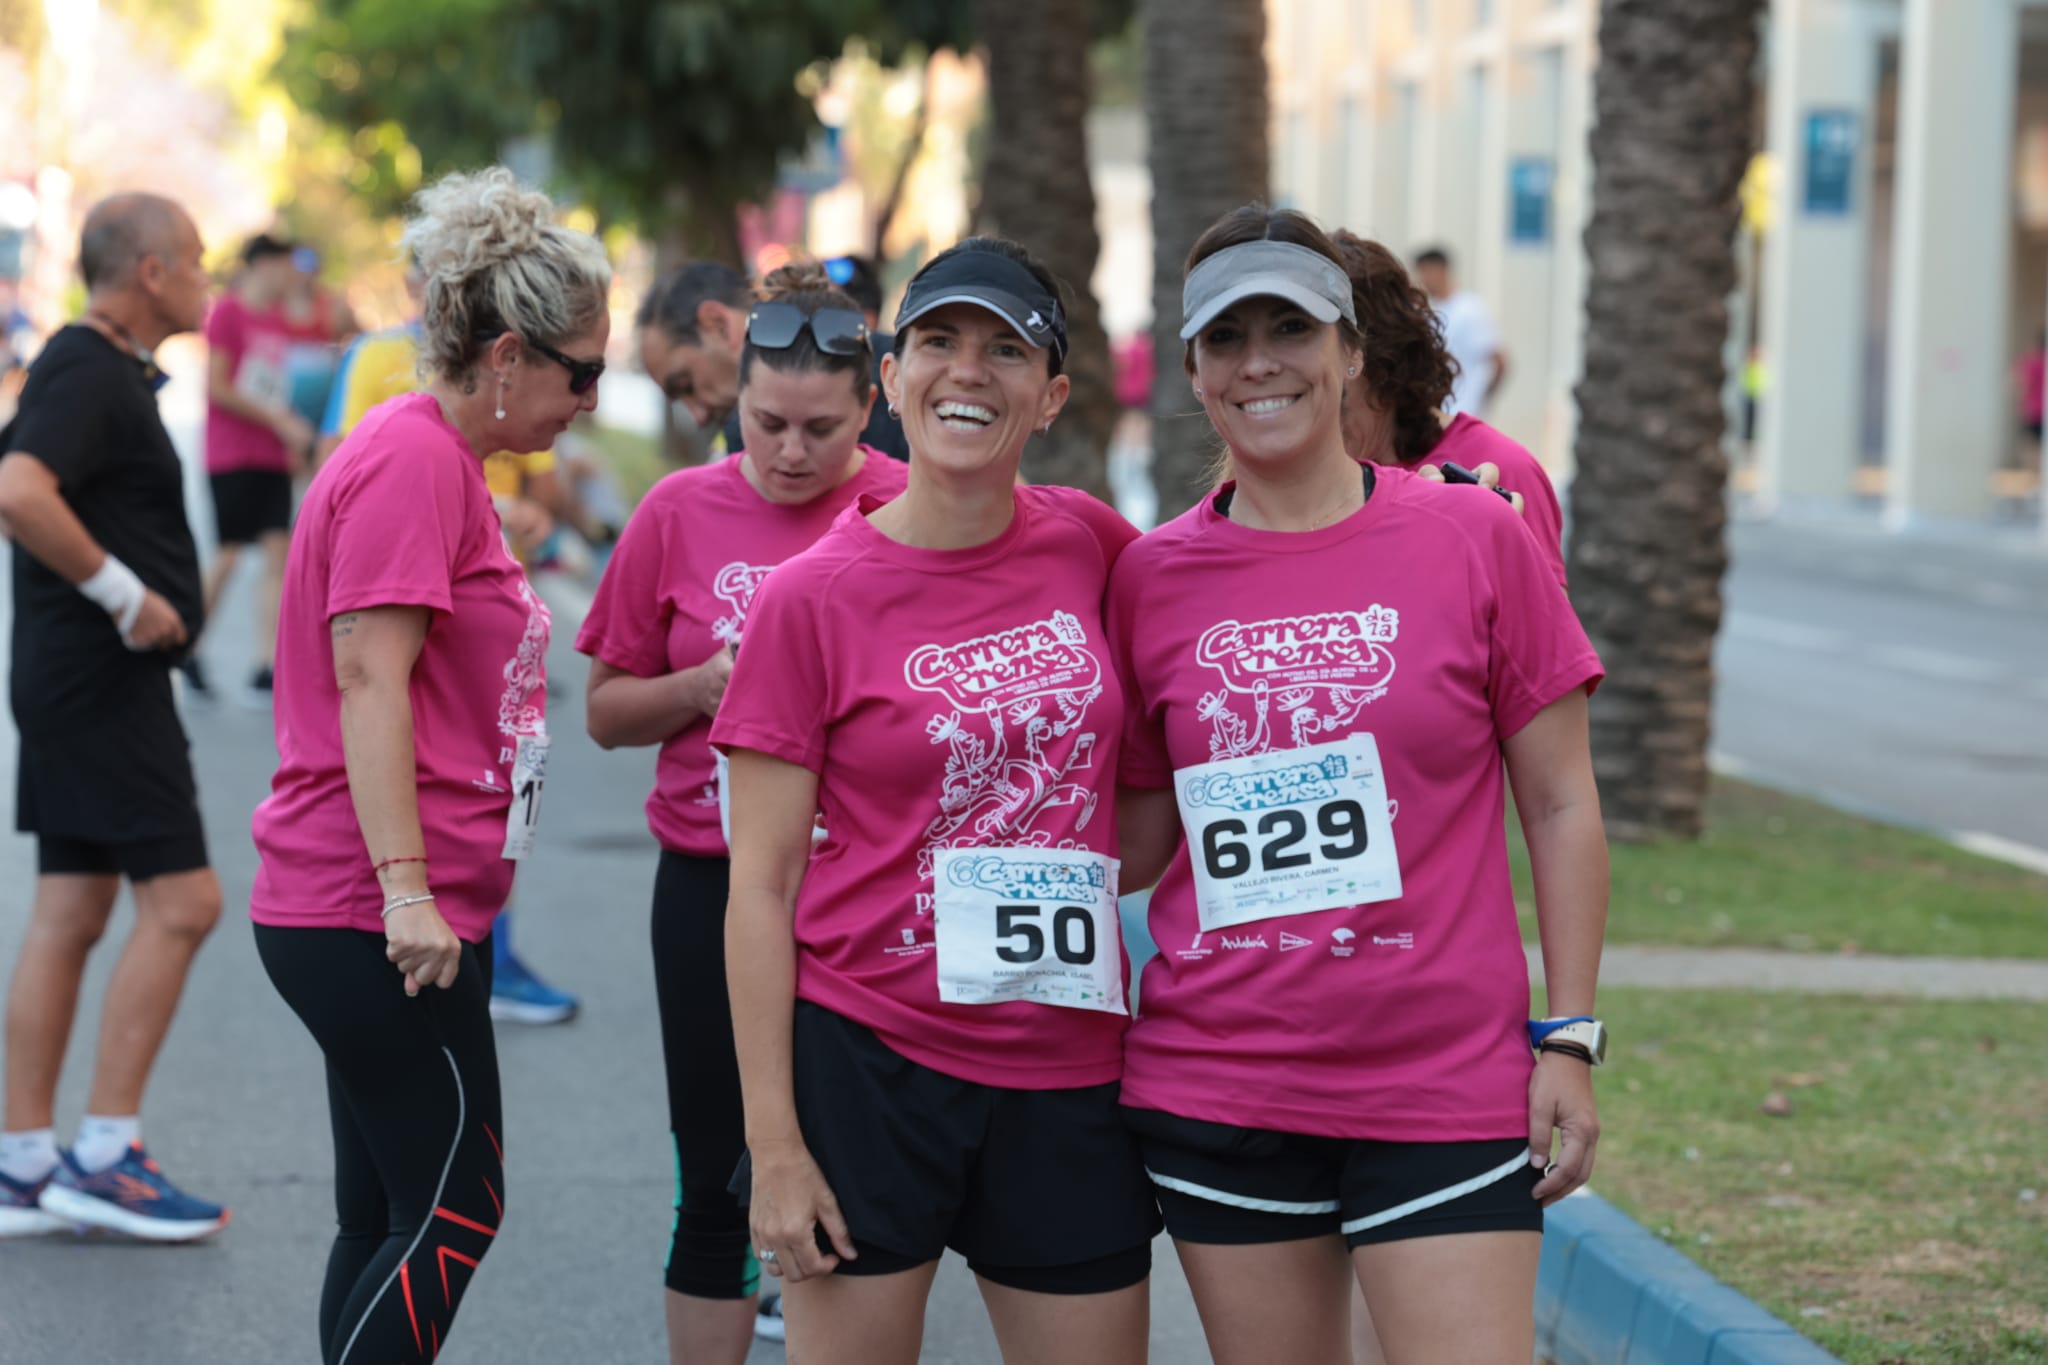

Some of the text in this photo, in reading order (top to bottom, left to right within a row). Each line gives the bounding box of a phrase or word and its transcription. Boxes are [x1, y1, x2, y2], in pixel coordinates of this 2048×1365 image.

[919, 614, 1075, 680] Carrera de
[1061, 628, 1083, 640] la
[1208, 609, 1392, 656] Carrera de
[1368, 624, 1391, 637] la
[953, 643, 1079, 697] Prensa
[1233, 639, 1372, 675] Prensa
[1207, 763, 1324, 800] Carrera
[1230, 779, 1335, 811] Prensa
[1202, 799, 1368, 879] 629
[975, 857, 1089, 884] Carrera
[1232, 866, 1339, 890] VALLEJO RIVERA, CARMEN
[1004, 882, 1096, 903] Prensa
[996, 905, 1095, 965] 50
